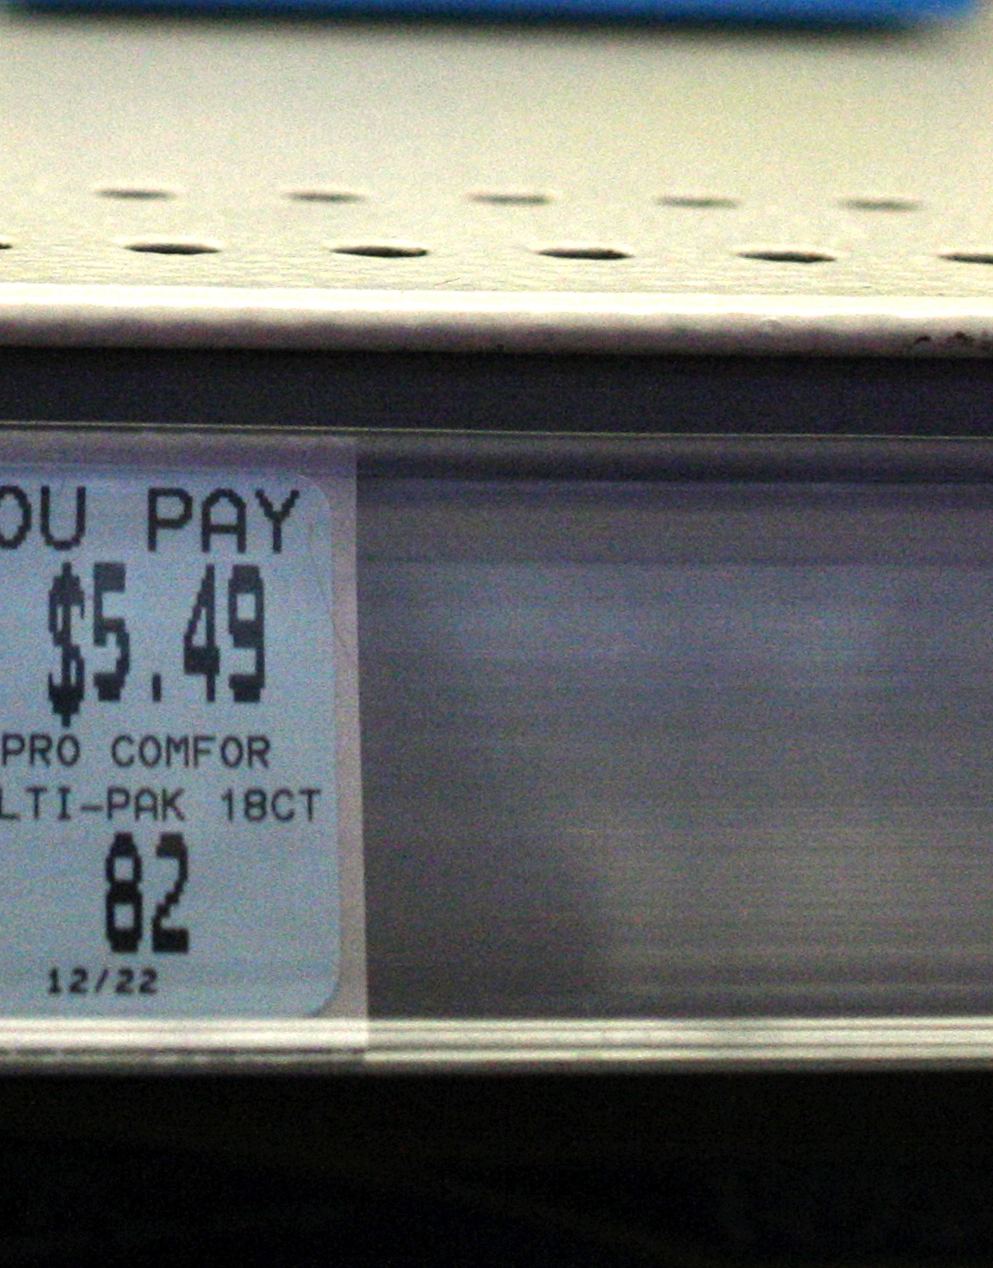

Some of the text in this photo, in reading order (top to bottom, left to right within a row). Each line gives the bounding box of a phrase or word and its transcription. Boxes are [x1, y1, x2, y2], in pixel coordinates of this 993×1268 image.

[148, 488, 300, 554] PAY
[48, 562, 266, 728] $5.49
[2, 734, 81, 767] PRO
[111, 736, 271, 769] COMFOR
[220, 789, 323, 822] 18CT
[107, 833, 190, 955] 82
[47, 967, 160, 996] 12/22
